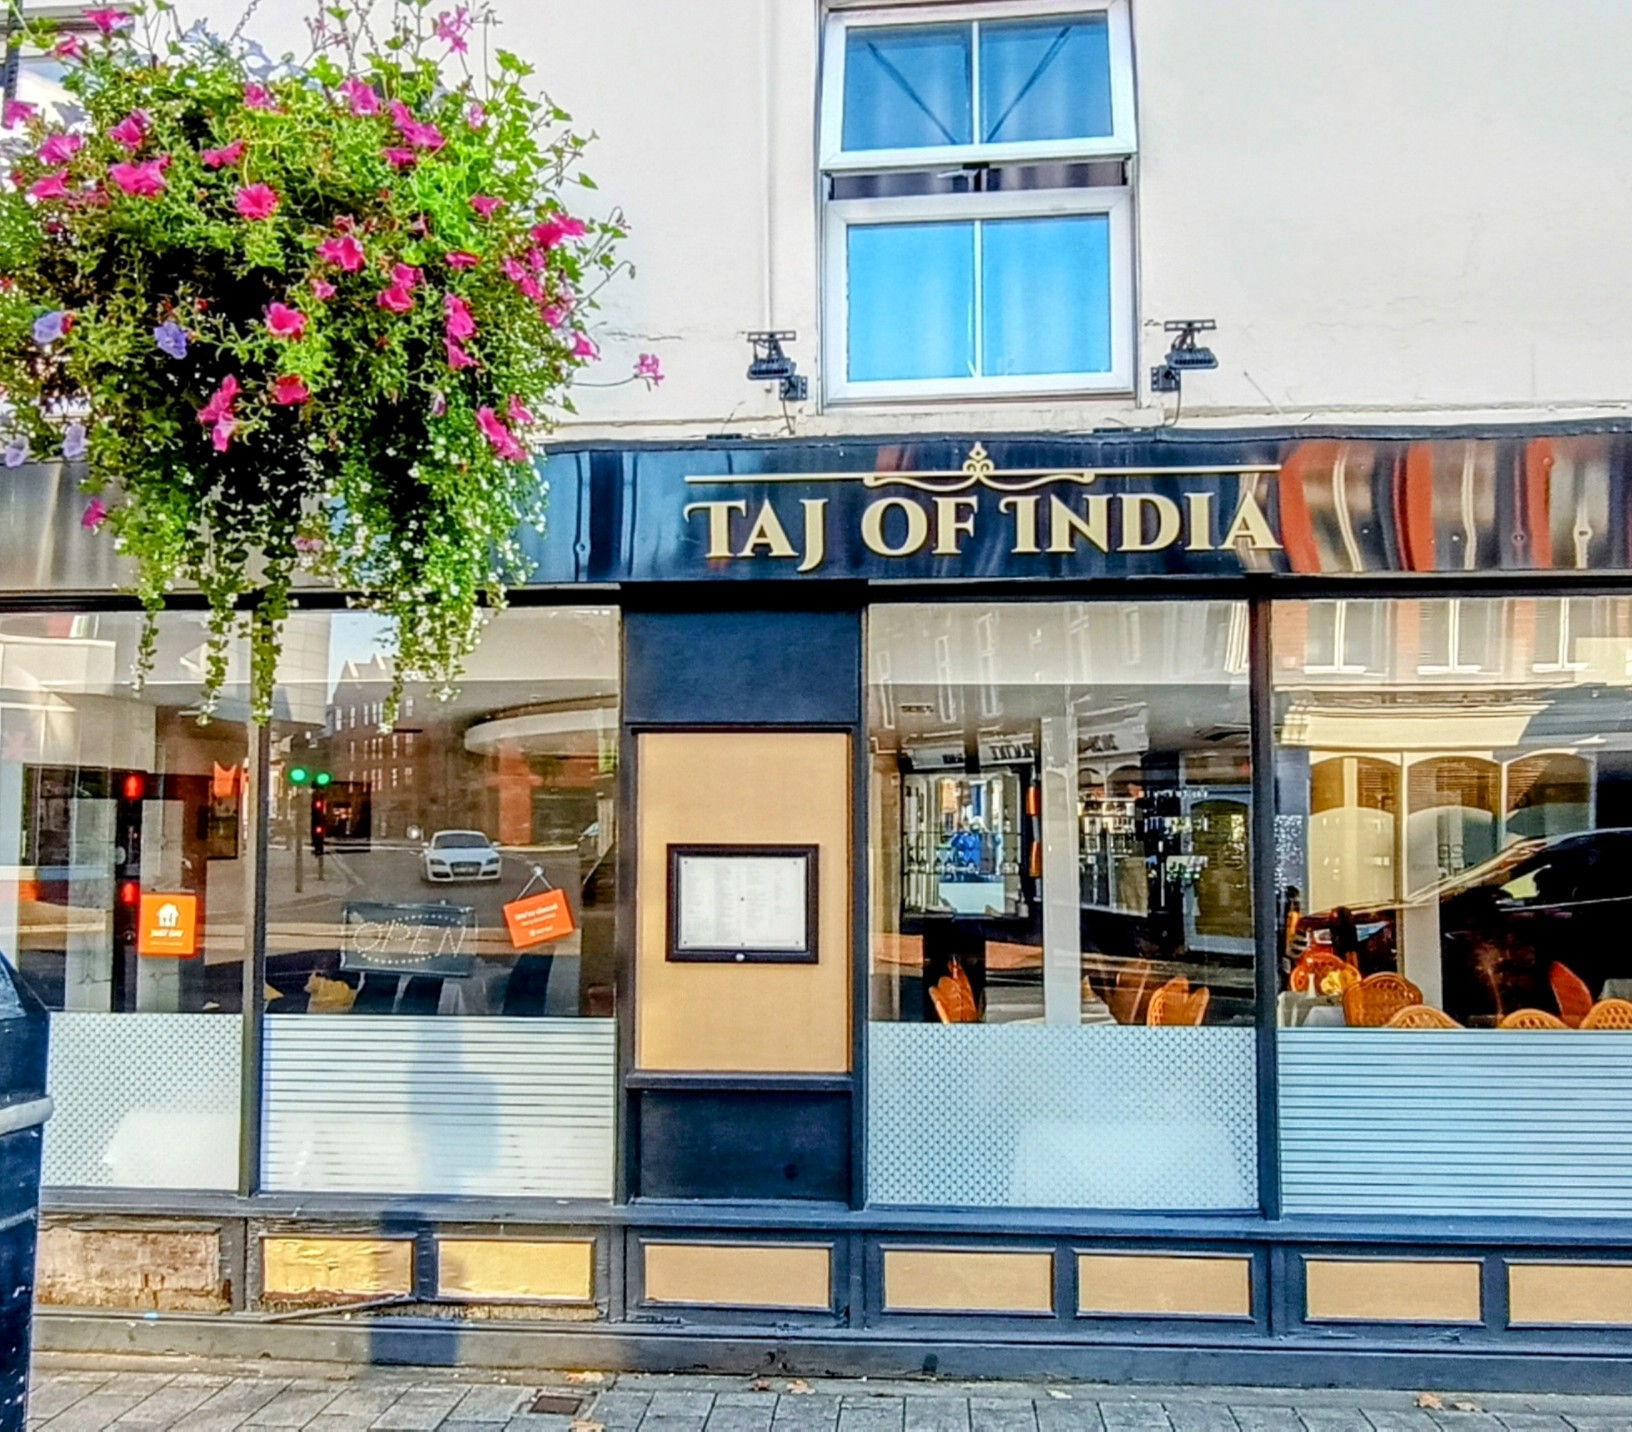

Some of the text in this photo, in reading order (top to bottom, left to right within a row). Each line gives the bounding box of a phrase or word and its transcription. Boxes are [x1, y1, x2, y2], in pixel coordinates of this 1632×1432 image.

[684, 490, 1284, 572] TAJ OF INDIA
[352, 919, 467, 958] OPEN
